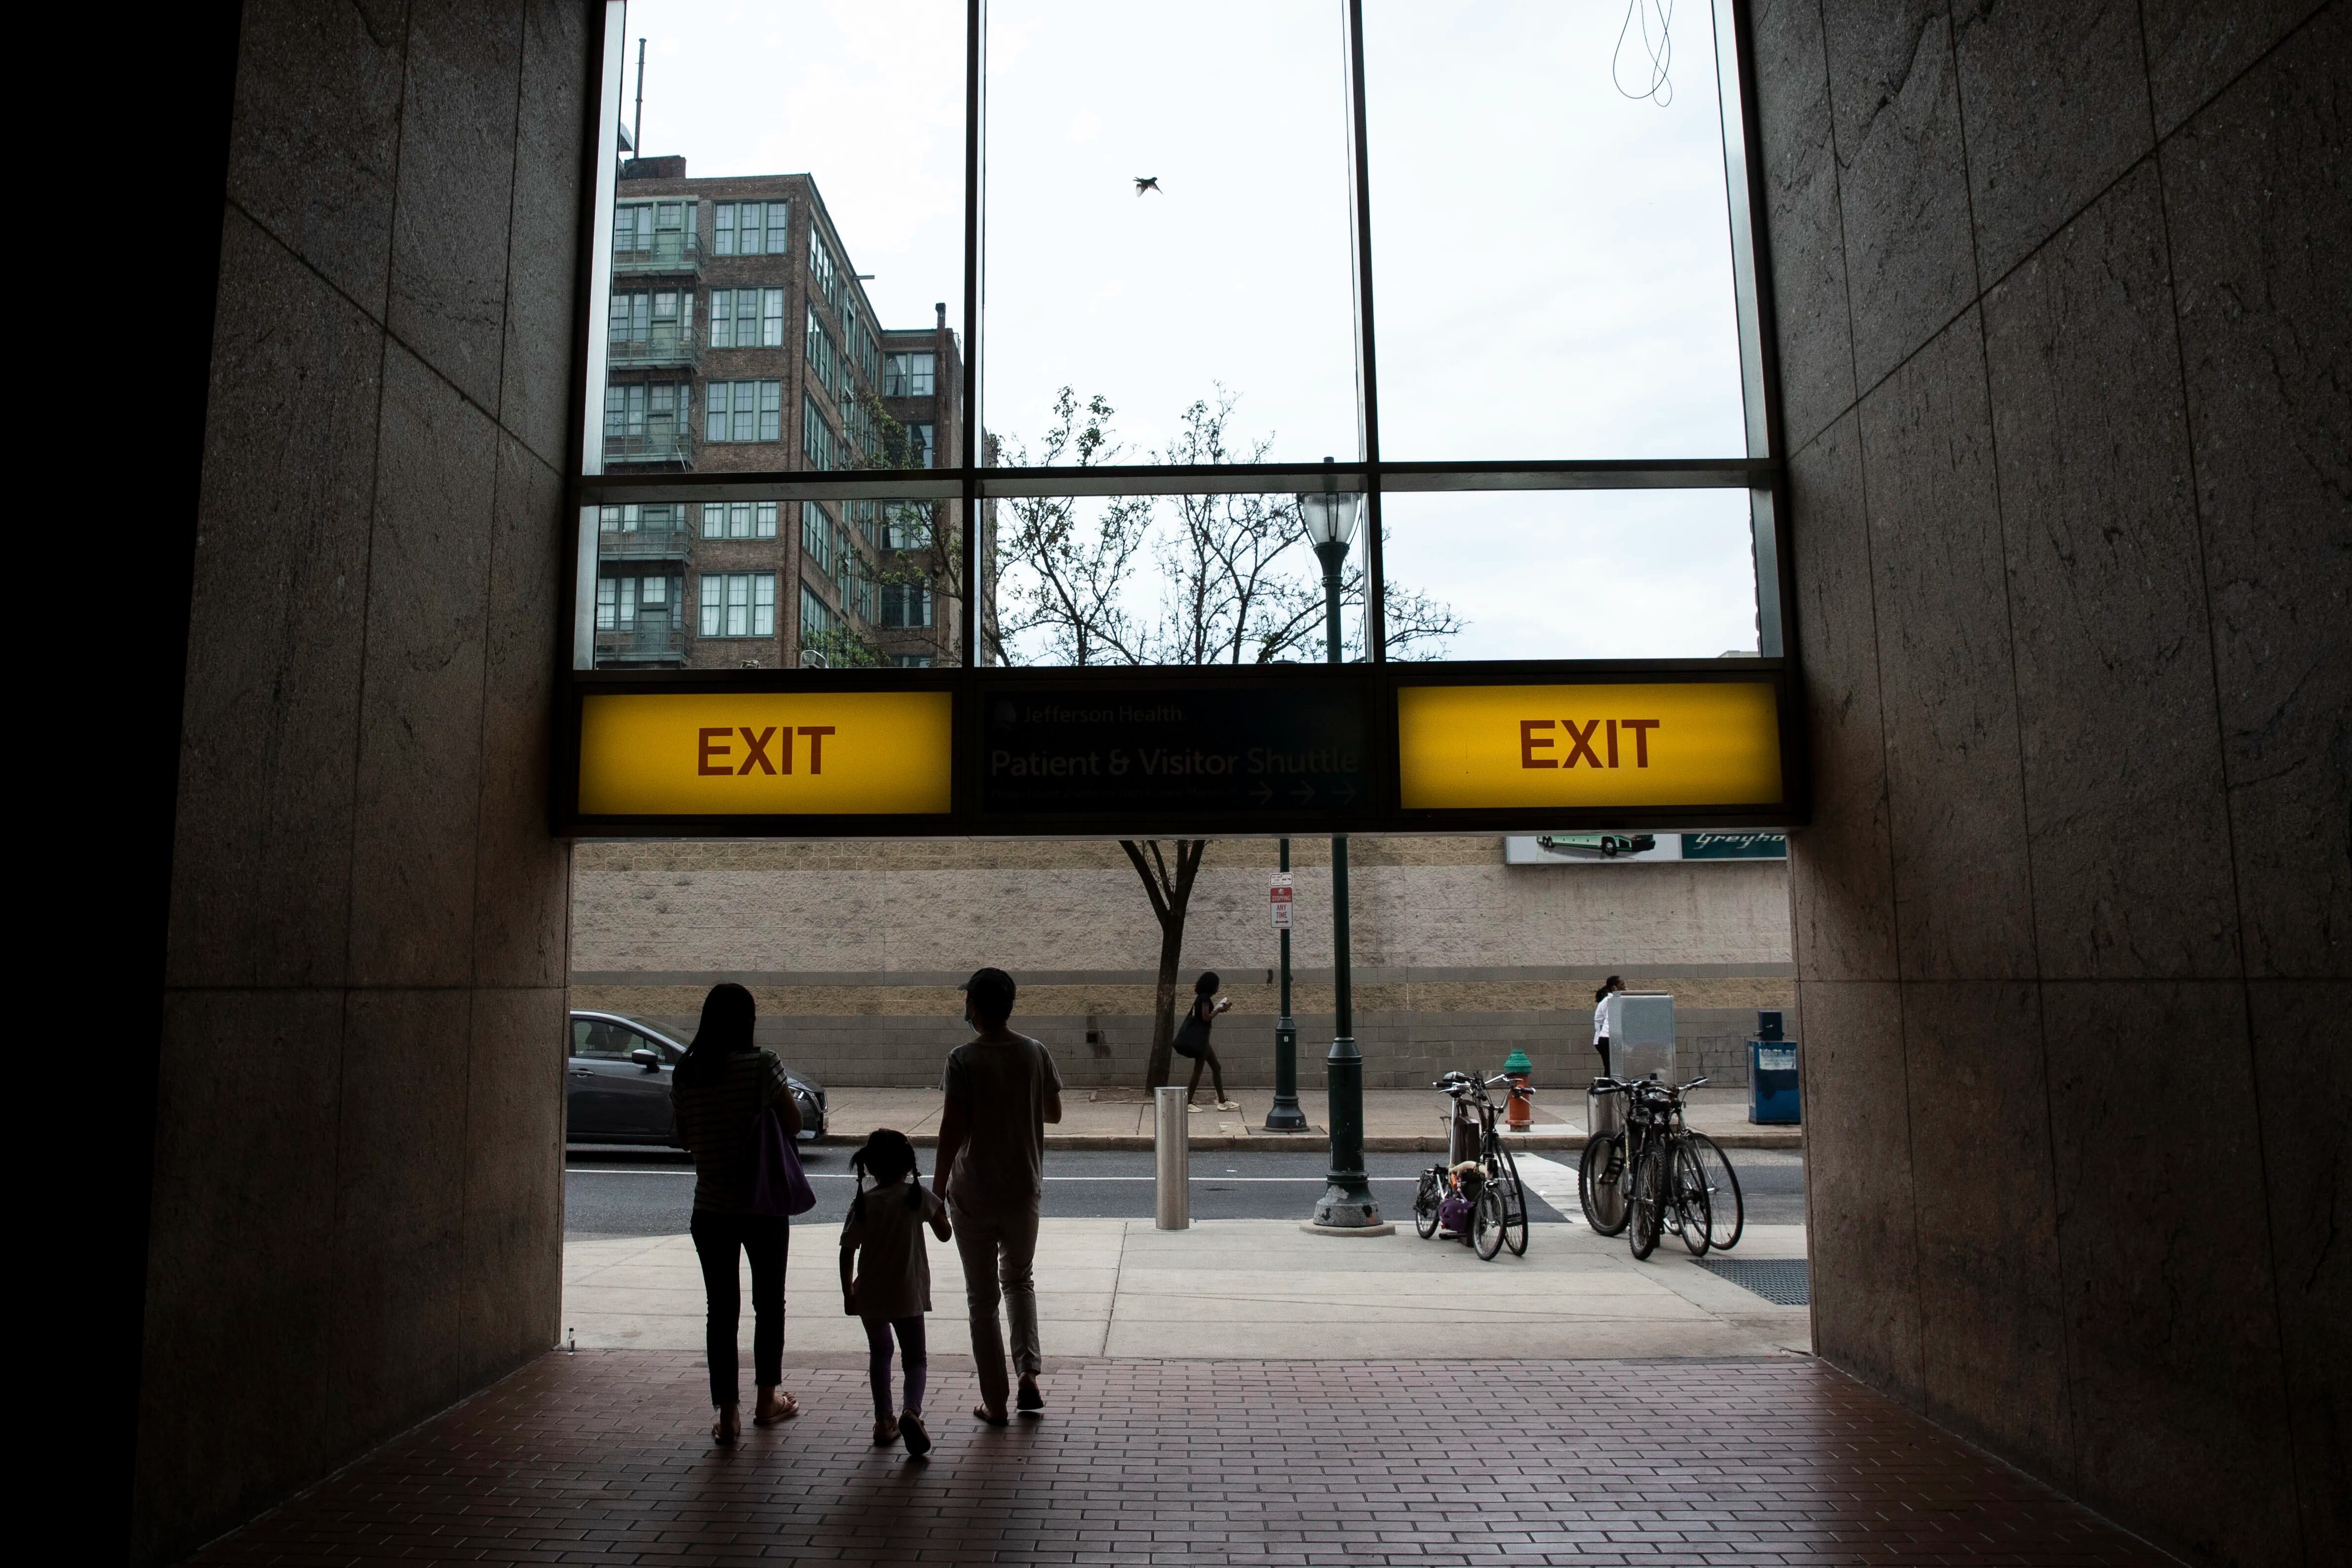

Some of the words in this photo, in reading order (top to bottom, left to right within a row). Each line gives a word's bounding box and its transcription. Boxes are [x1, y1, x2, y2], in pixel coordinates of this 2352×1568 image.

[1023, 705, 1114, 723] Jefferson
[698, 726, 835, 776] EXIT
[992, 750, 1100, 776] Patient
[1108, 748, 1131, 776] &
[1137, 747, 1239, 775] Visitor
[1247, 746, 1360, 774] Shuttle
[1520, 719, 1660, 769] EXIT
